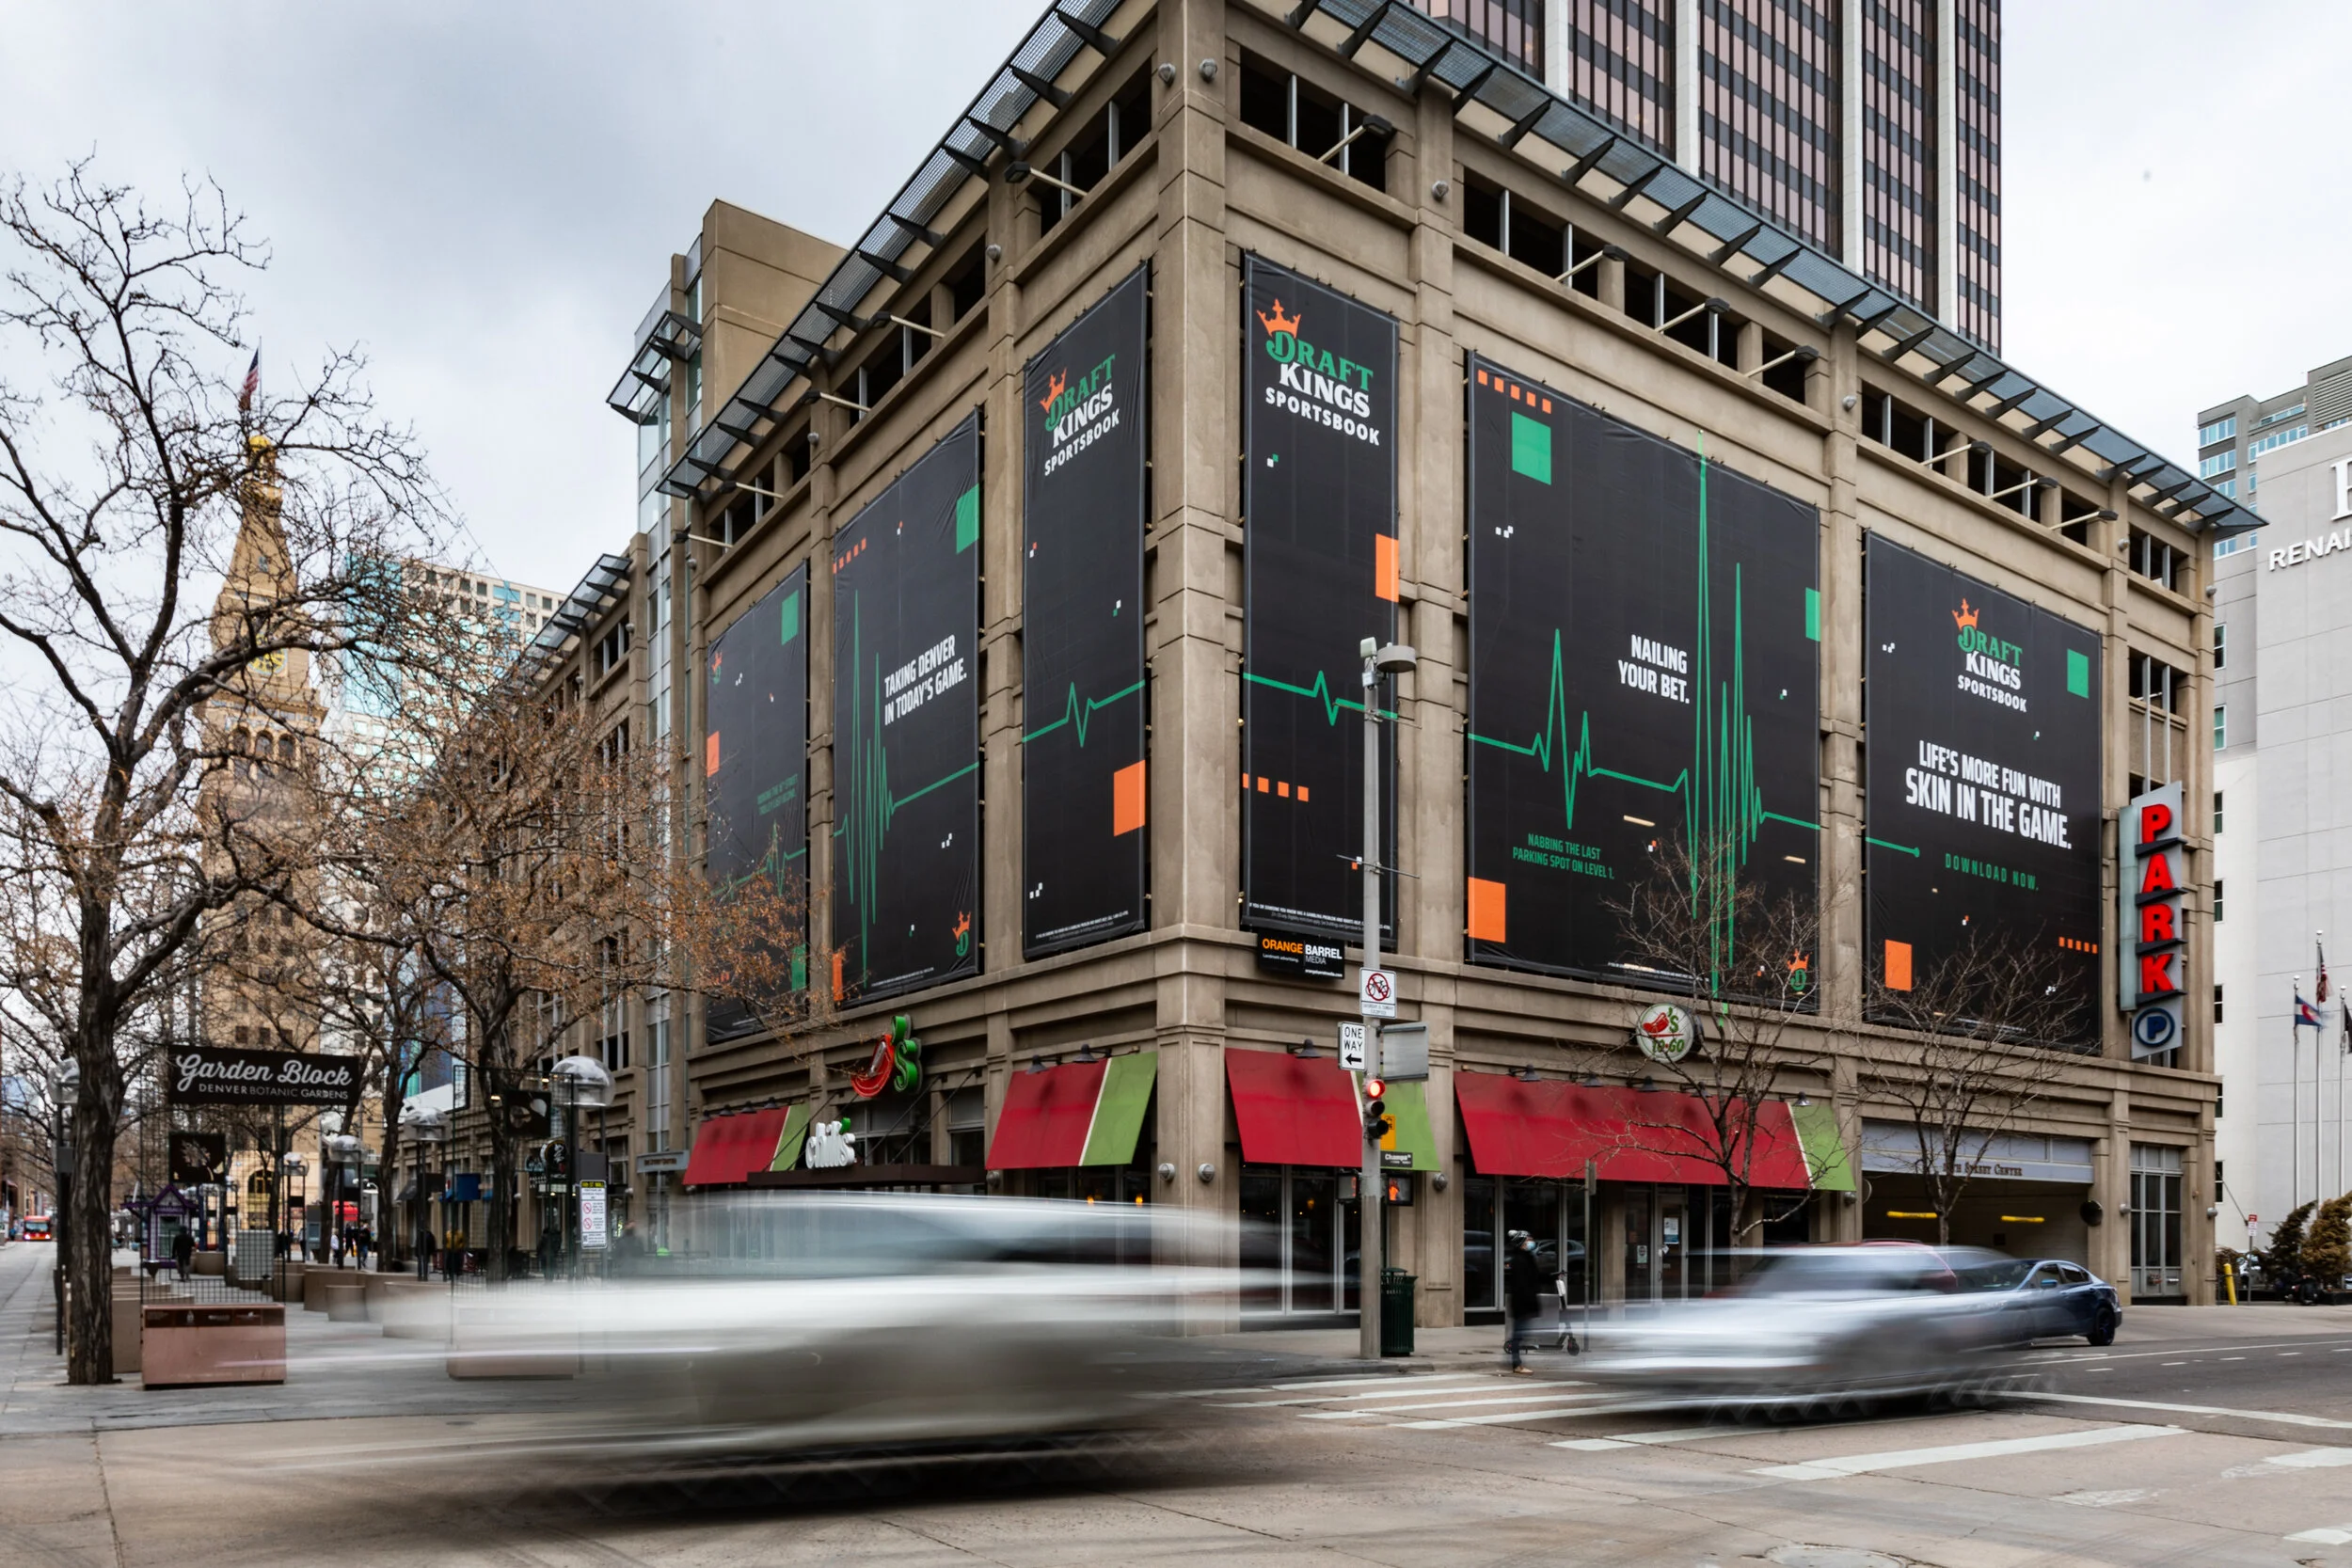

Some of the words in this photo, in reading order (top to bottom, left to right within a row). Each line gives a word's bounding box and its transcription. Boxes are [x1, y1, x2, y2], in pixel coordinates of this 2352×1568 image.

[1266, 331, 1374, 391] DRAFT
[1045, 354, 1116, 432] DRAFT
[1279, 362, 1371, 419] KINGS
[1052, 383, 1114, 449] KINGS
[1265, 387, 1380, 446] SPORTSBOOK
[1044, 409, 1120, 476] SPORTSBOOK
[884, 659, 916, 698] TAKING
[918, 634, 955, 678] DENVER
[1631, 634, 1687, 674] NAILING
[1957, 626, 2023, 667] DRAFT
[1618, 659, 1657, 694] YOUR
[1661, 673, 1690, 705] BET.
[1965, 650, 2021, 690] KINGS
[884, 701, 895, 726] IN
[896, 677, 933, 719] TODAY'S
[935, 657, 967, 695] GAME.
[1957, 674, 2027, 712] SPORTSBOOK
[1919, 739, 1959, 776] LIFE'S
[1962, 753, 1999, 790] MORE
[2001, 767, 2026, 798] FUN
[2028, 775, 2061, 809] WITH
[1905, 768, 1951, 815] SKIN
[1957, 783, 1976, 822] IN
[1980, 790, 2014, 833] THE
[2019, 803, 2072, 849] GAME.
[1513, 847, 1548, 865] PARKING
[1549, 854, 1571, 870] SPOT
[1572, 860, 1583, 873] ON
[1584, 862, 1607, 878] LEVEL
[1528, 832, 1564, 853] NABBING
[1565, 841, 1581, 856] THE
[1581, 845, 1601, 861] LAST
[1945, 853, 2008, 883] DOWNLOAD
[2012, 871, 2039, 891] NOW.
[2141, 803, 2174, 993] PARK
[1262, 938, 1303, 954] ORANGE
[1305, 944, 1343, 959] BARREL
[1305, 955, 1327, 965] MEDIA
[1343, 1039, 1363, 1052] WAY
[1344, 1026, 1362, 1038] ONE
[176, 1053, 274, 1092] Garden
[278, 1059, 353, 1086] Block
[199, 1084, 247, 1095] DENVER
[249, 1086, 299, 1098] BOTANIC
[301, 1089, 349, 1100] GARDENS
